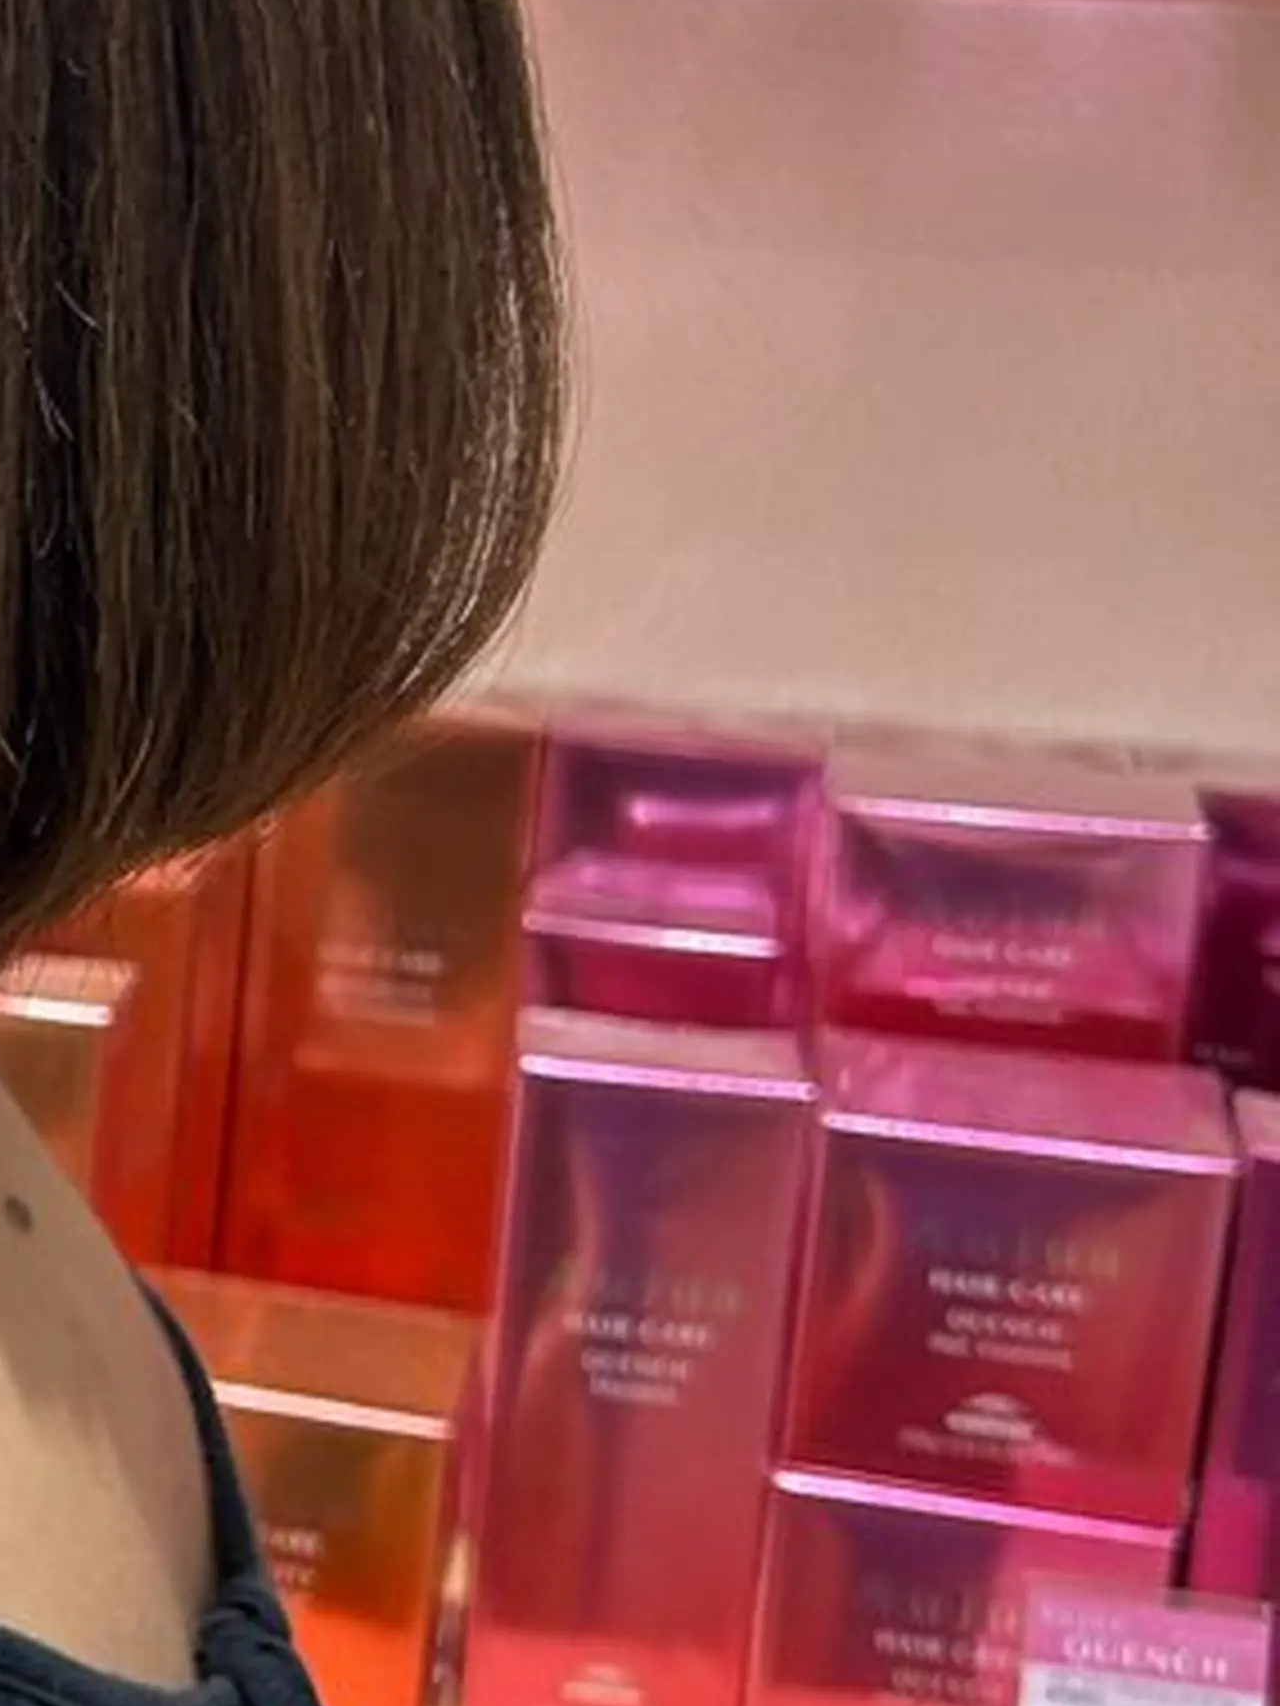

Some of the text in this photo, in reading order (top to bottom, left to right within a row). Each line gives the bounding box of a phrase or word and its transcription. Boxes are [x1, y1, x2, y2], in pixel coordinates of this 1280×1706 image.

[926, 1268, 1083, 1313] HAIR CARE
[561, 1309, 713, 1350] HAIR CARE
[1063, 1637, 1230, 1683] QUENCH
